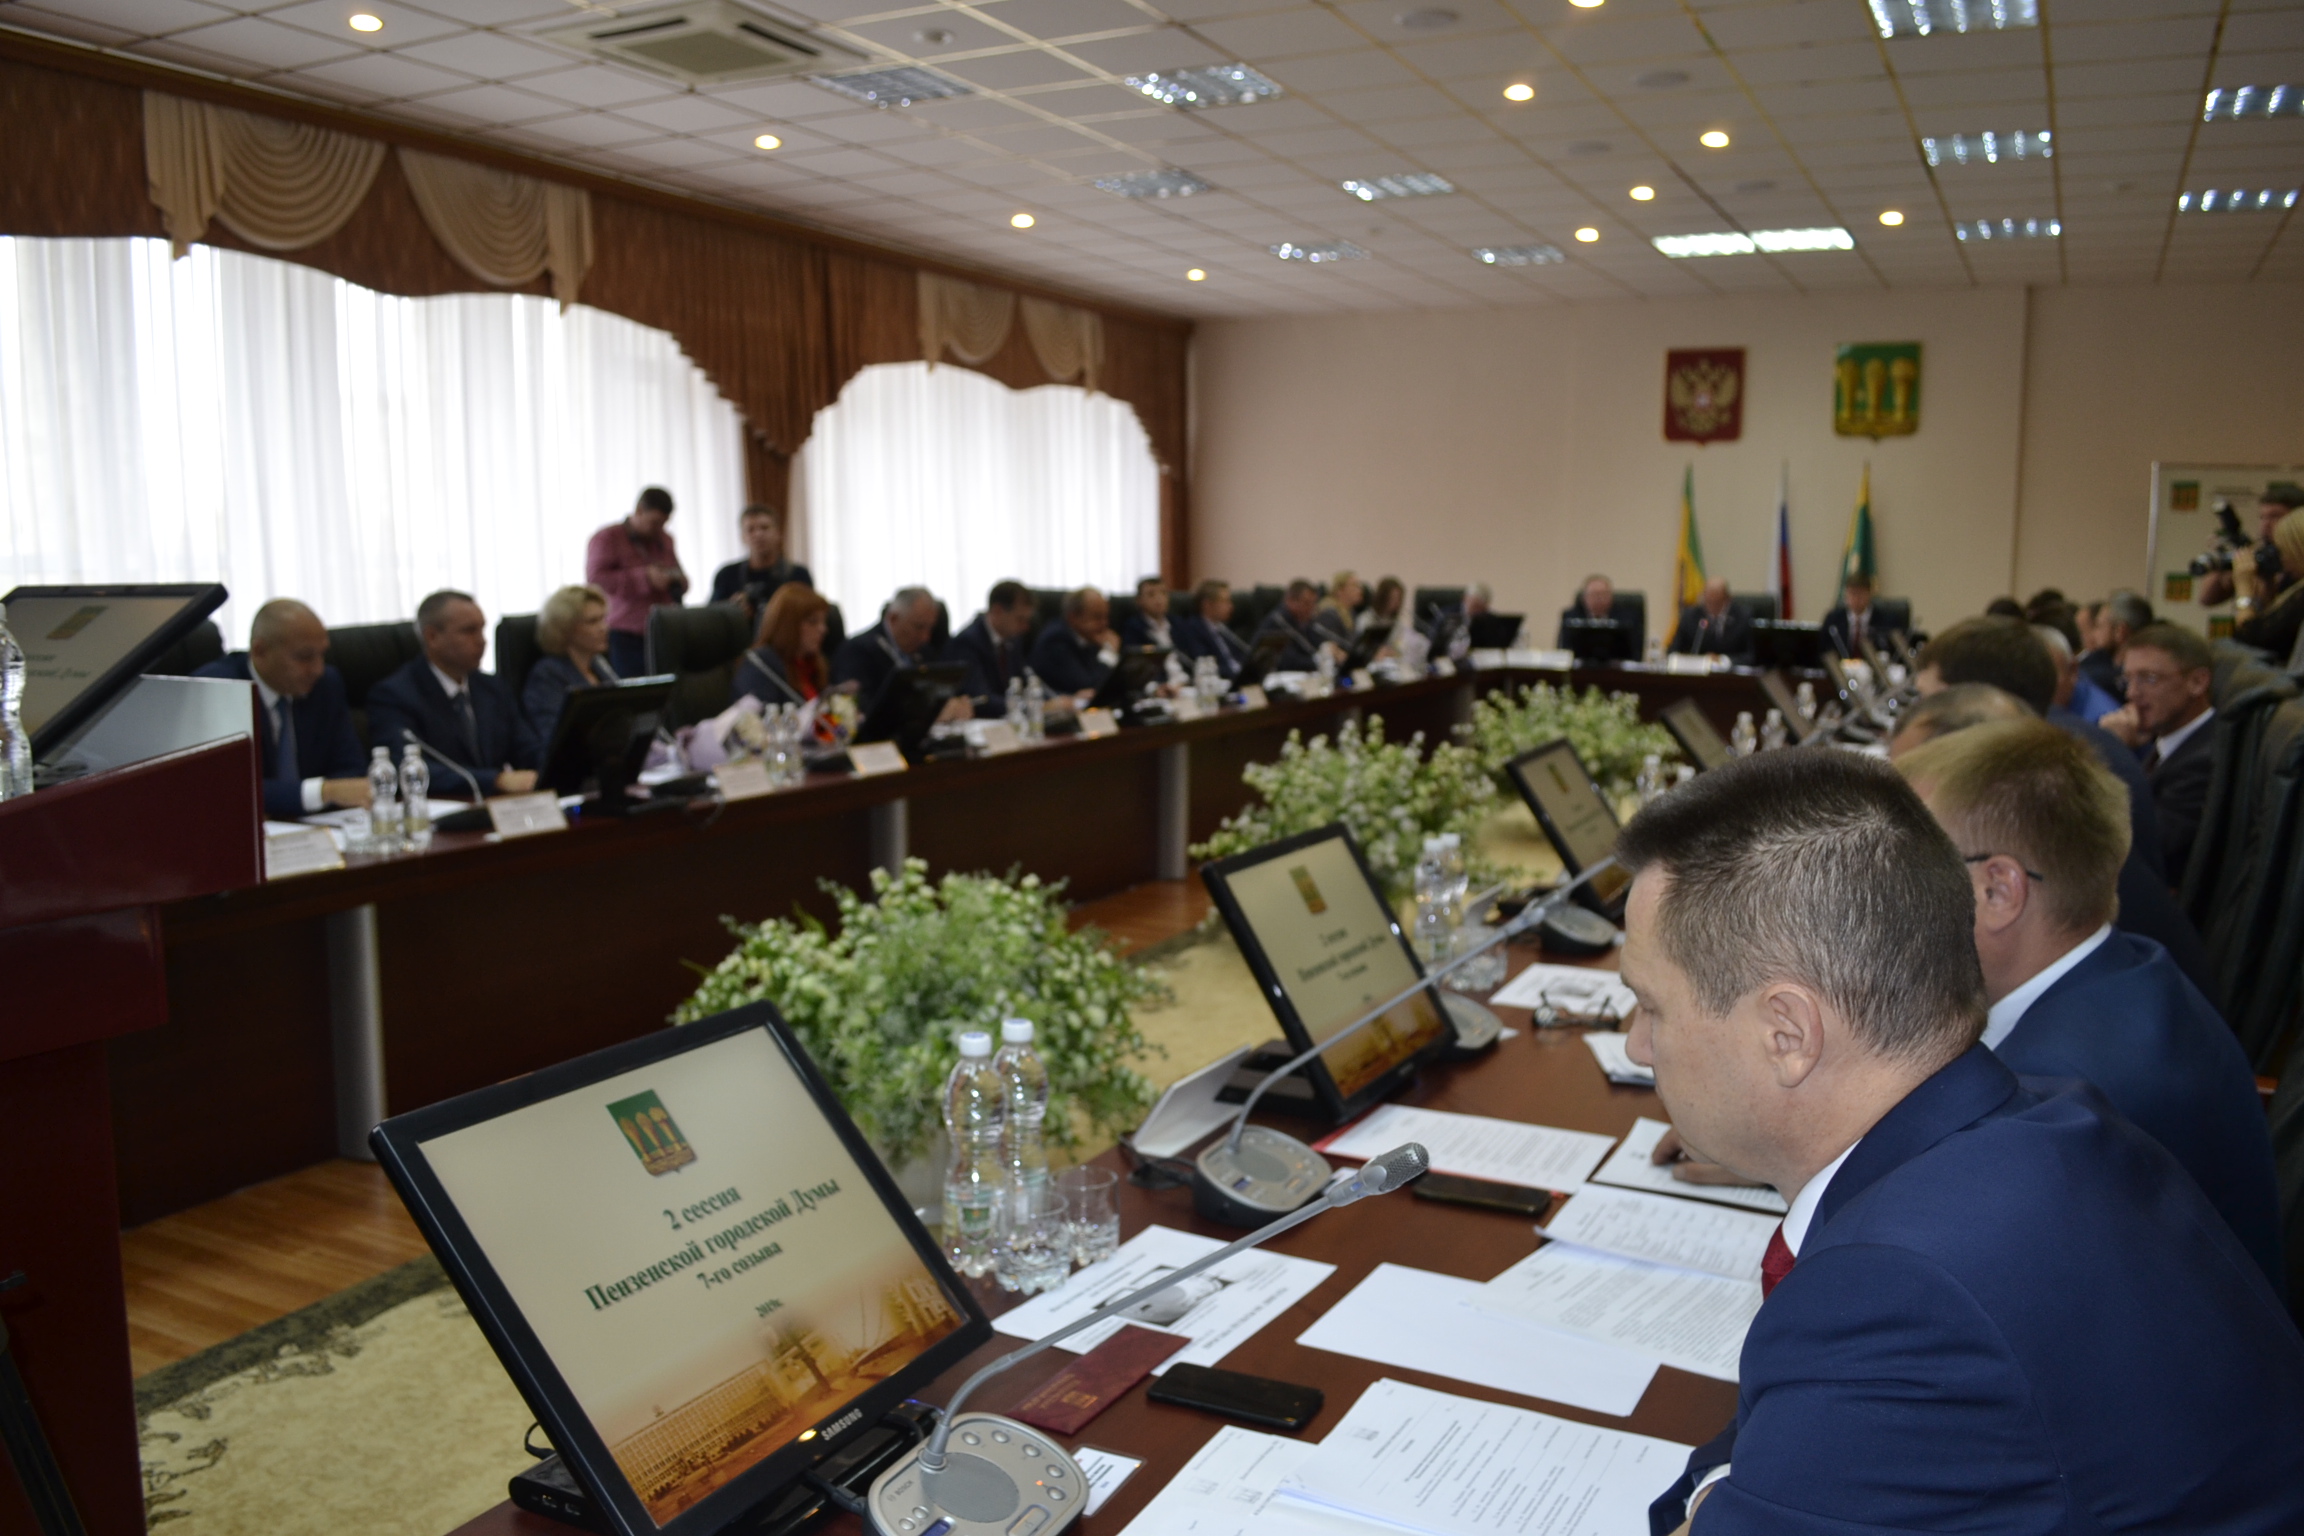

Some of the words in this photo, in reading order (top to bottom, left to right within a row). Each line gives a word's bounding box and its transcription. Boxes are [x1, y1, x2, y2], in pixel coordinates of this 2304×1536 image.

[662, 1208, 683, 1231] 2
[681, 1186, 742, 1224] сессия
[583, 1240, 706, 1311] Пензенской
[703, 1197, 793, 1253] городской
[788, 1178, 841, 1216] Думы
[696, 1266, 732, 1290] 7-го
[730, 1240, 784, 1274] созыва
[820, 1408, 863, 1441] SAMSUNG
